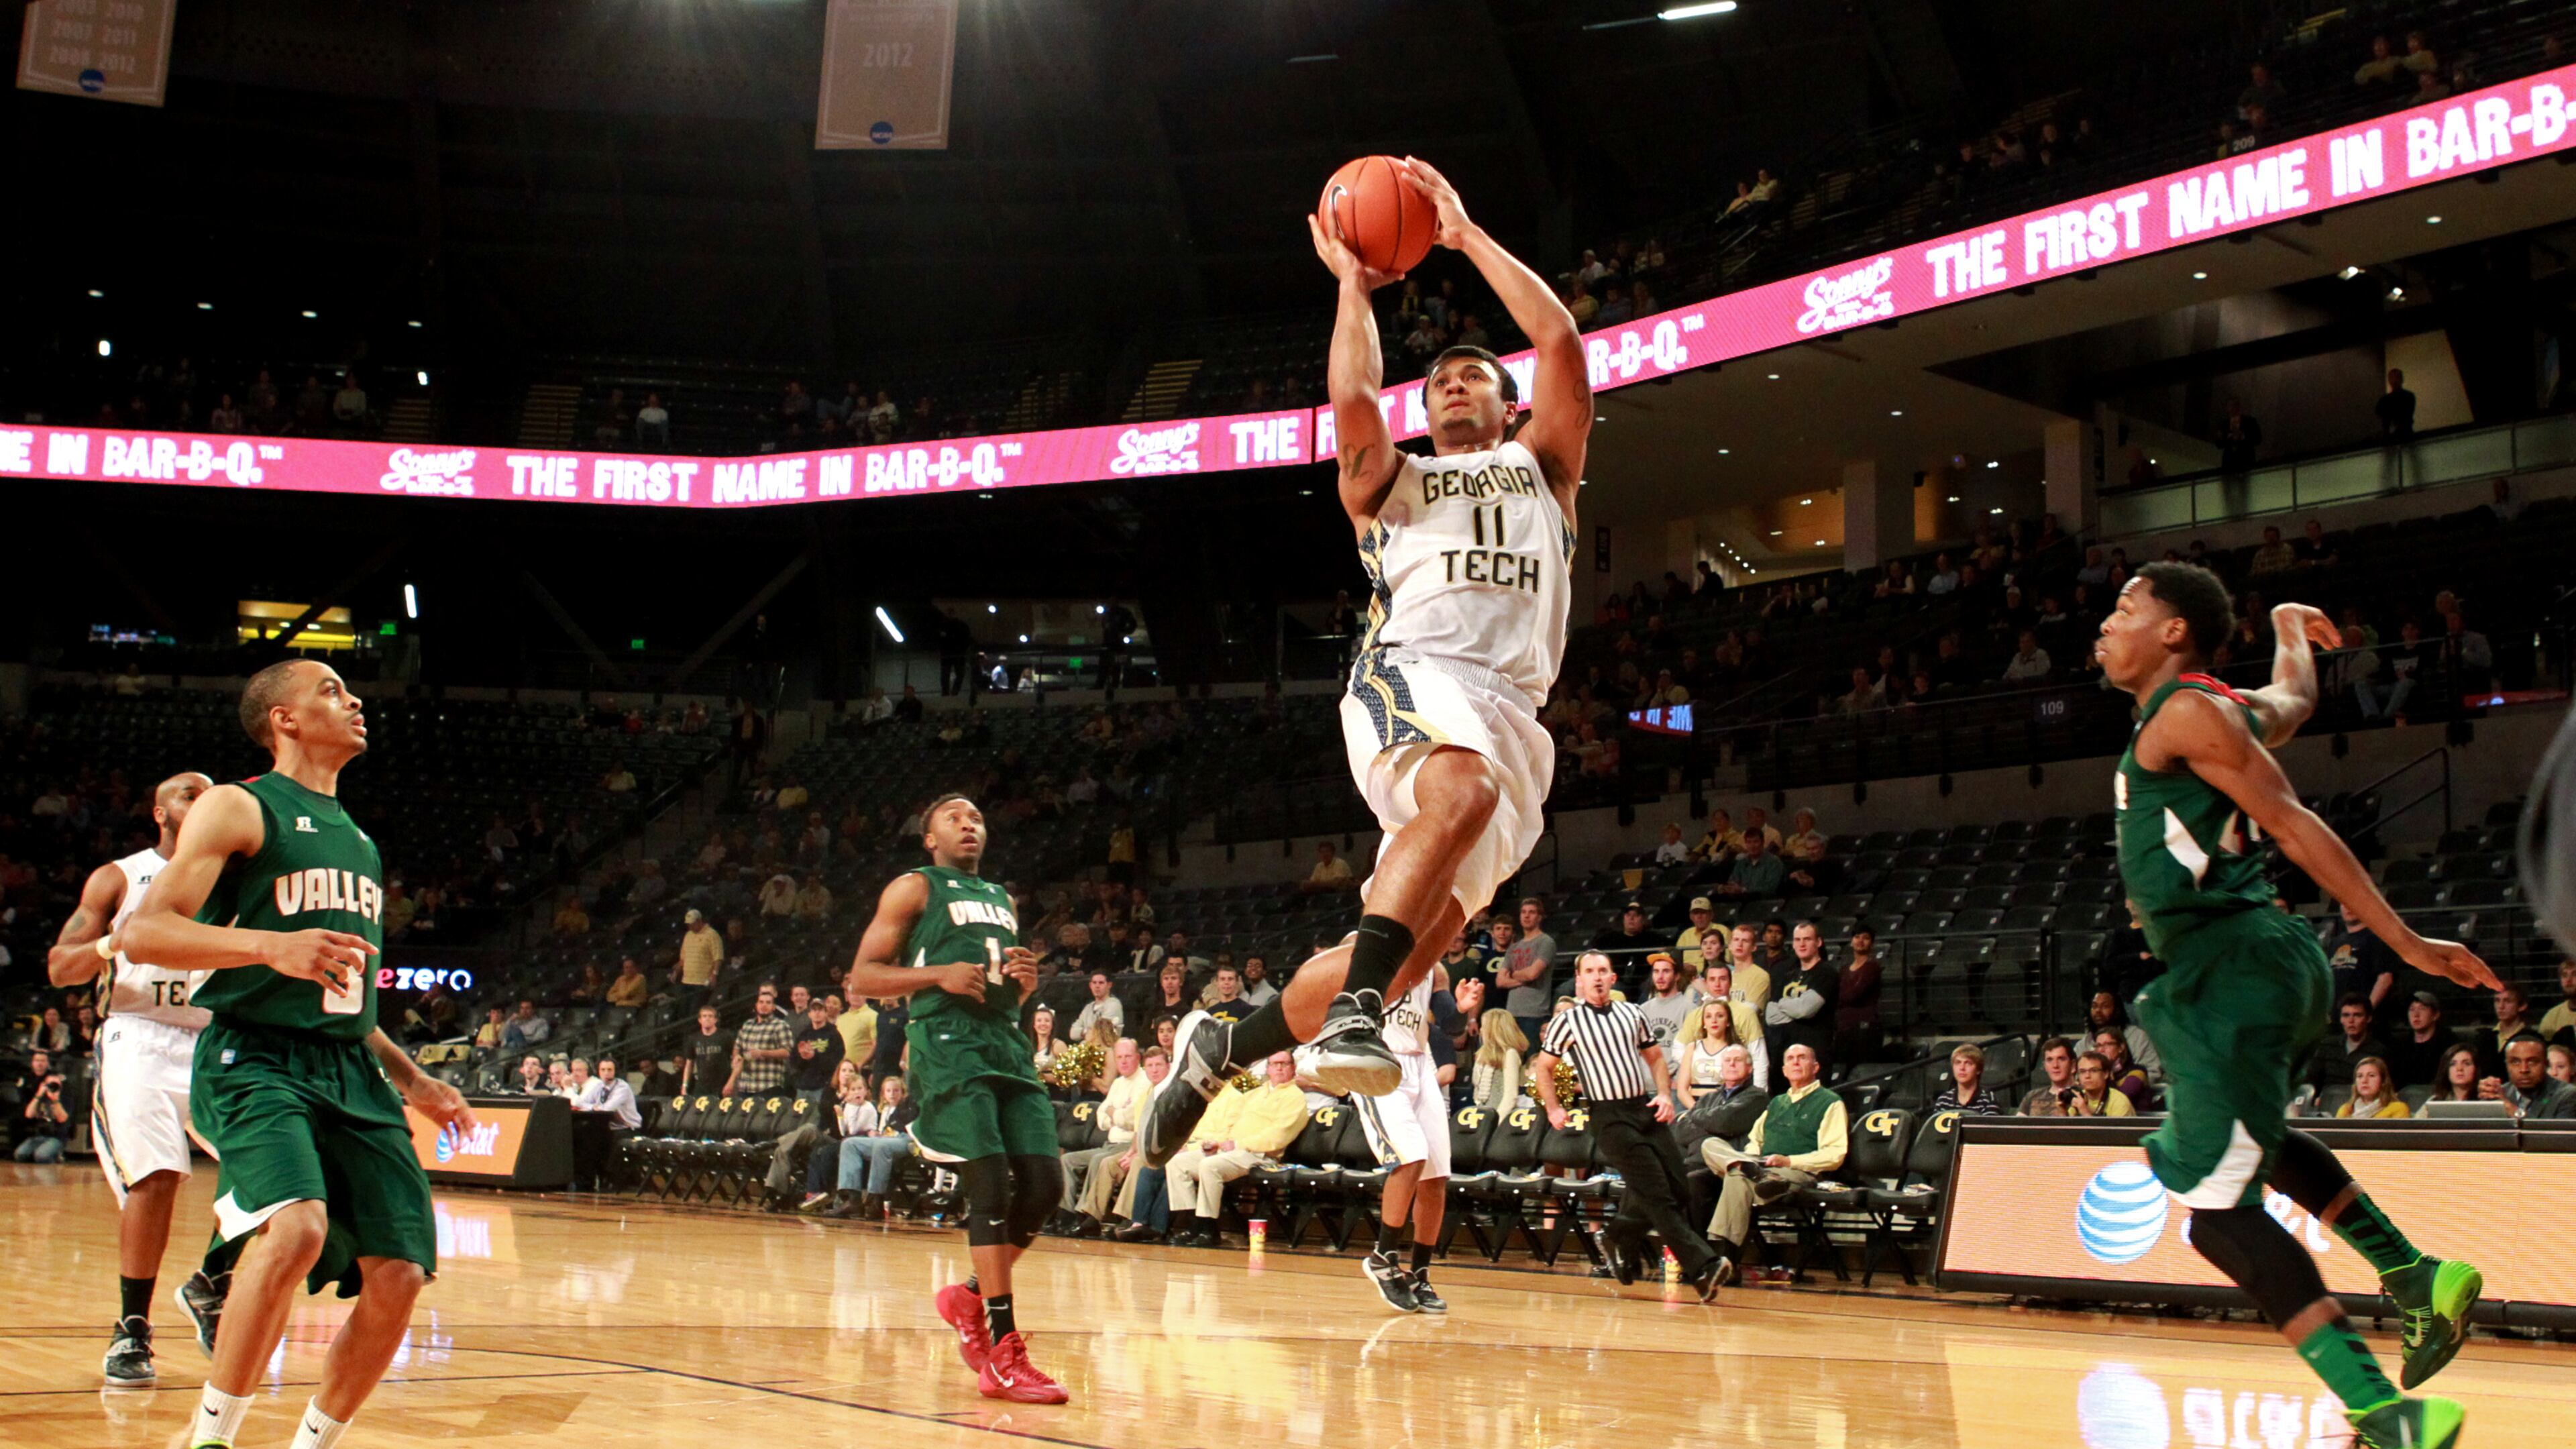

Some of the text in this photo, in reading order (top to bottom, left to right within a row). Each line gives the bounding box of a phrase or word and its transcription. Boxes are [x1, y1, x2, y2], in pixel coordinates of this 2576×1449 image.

[863, 43, 914, 67] 2012
[1927, 230, 2006, 297] THE
[2025, 193, 2148, 274] FIRST
[2169, 149, 2308, 237] NAME
[2330, 129, 2383, 196] IN
[1797, 258, 1893, 332] Sonny's
[48, 433, 88, 474] IN
[1110, 423, 1200, 474] Sonny's
[1230, 417, 1299, 462] THE
[507, 456, 578, 496] THE
[594, 460, 698, 501] FIRST
[712, 459, 806, 502] NAME
[820, 455, 851, 495] IN
[1422, 465, 1538, 504] GEORGIA
[1472, 504, 1504, 547] 11
[1440, 549, 1540, 593] TECH
[2041, 701, 2063, 716] 109
[274, 867, 383, 926] VALLEY
[948, 901, 1018, 935] VALLEY
[985, 936, 1004, 985] 1
